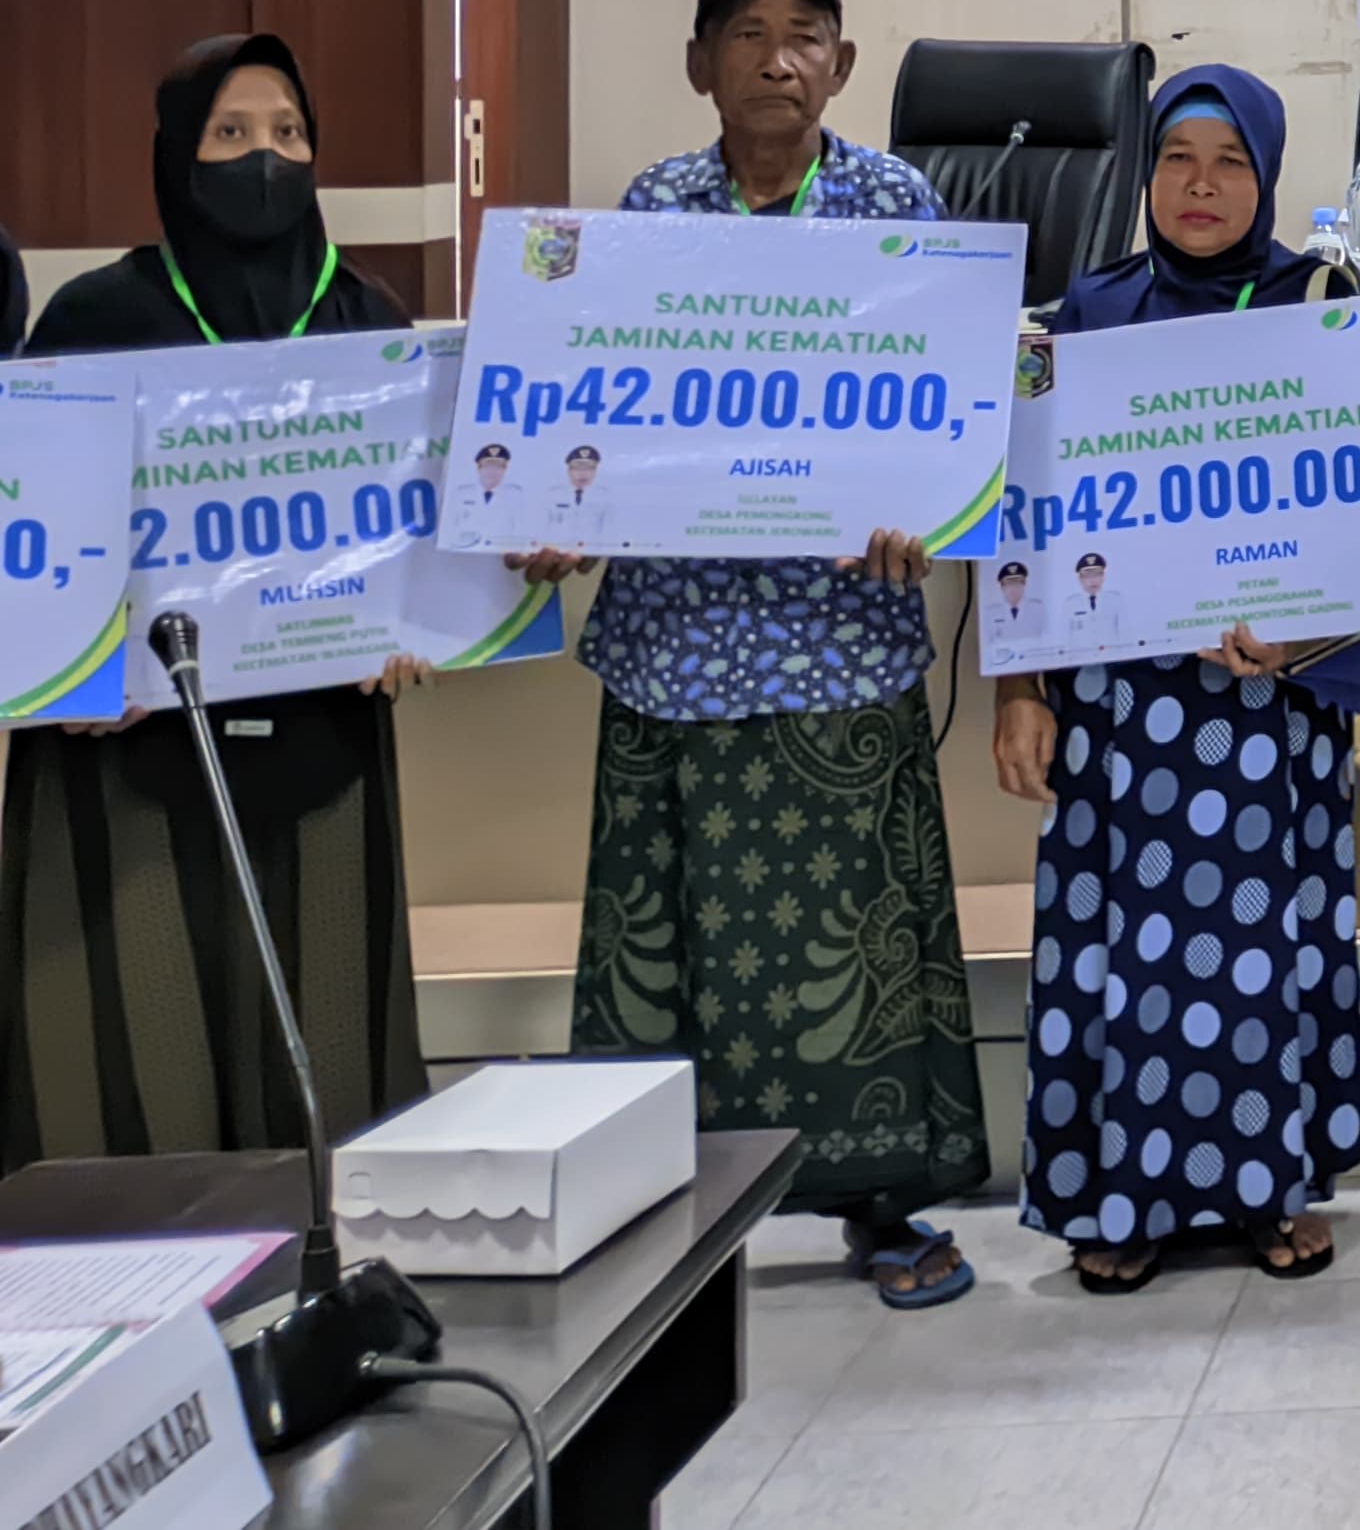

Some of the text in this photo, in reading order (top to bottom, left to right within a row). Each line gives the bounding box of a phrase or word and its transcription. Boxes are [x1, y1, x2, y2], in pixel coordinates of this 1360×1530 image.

[654, 291, 851, 319] SANTUNAN
[567, 325, 928, 356] JAMINAN KEMATIAN
[474, 363, 997, 440] Rp42.000.000,-
[1130, 377, 1305, 417] SANTUNAN
[157, 411, 363, 449] SANTUNAN
[1057, 422, 1204, 460] JAMINAN
[729, 458, 812, 476] AJISAH
[1215, 539, 1299, 565] RAMAN
